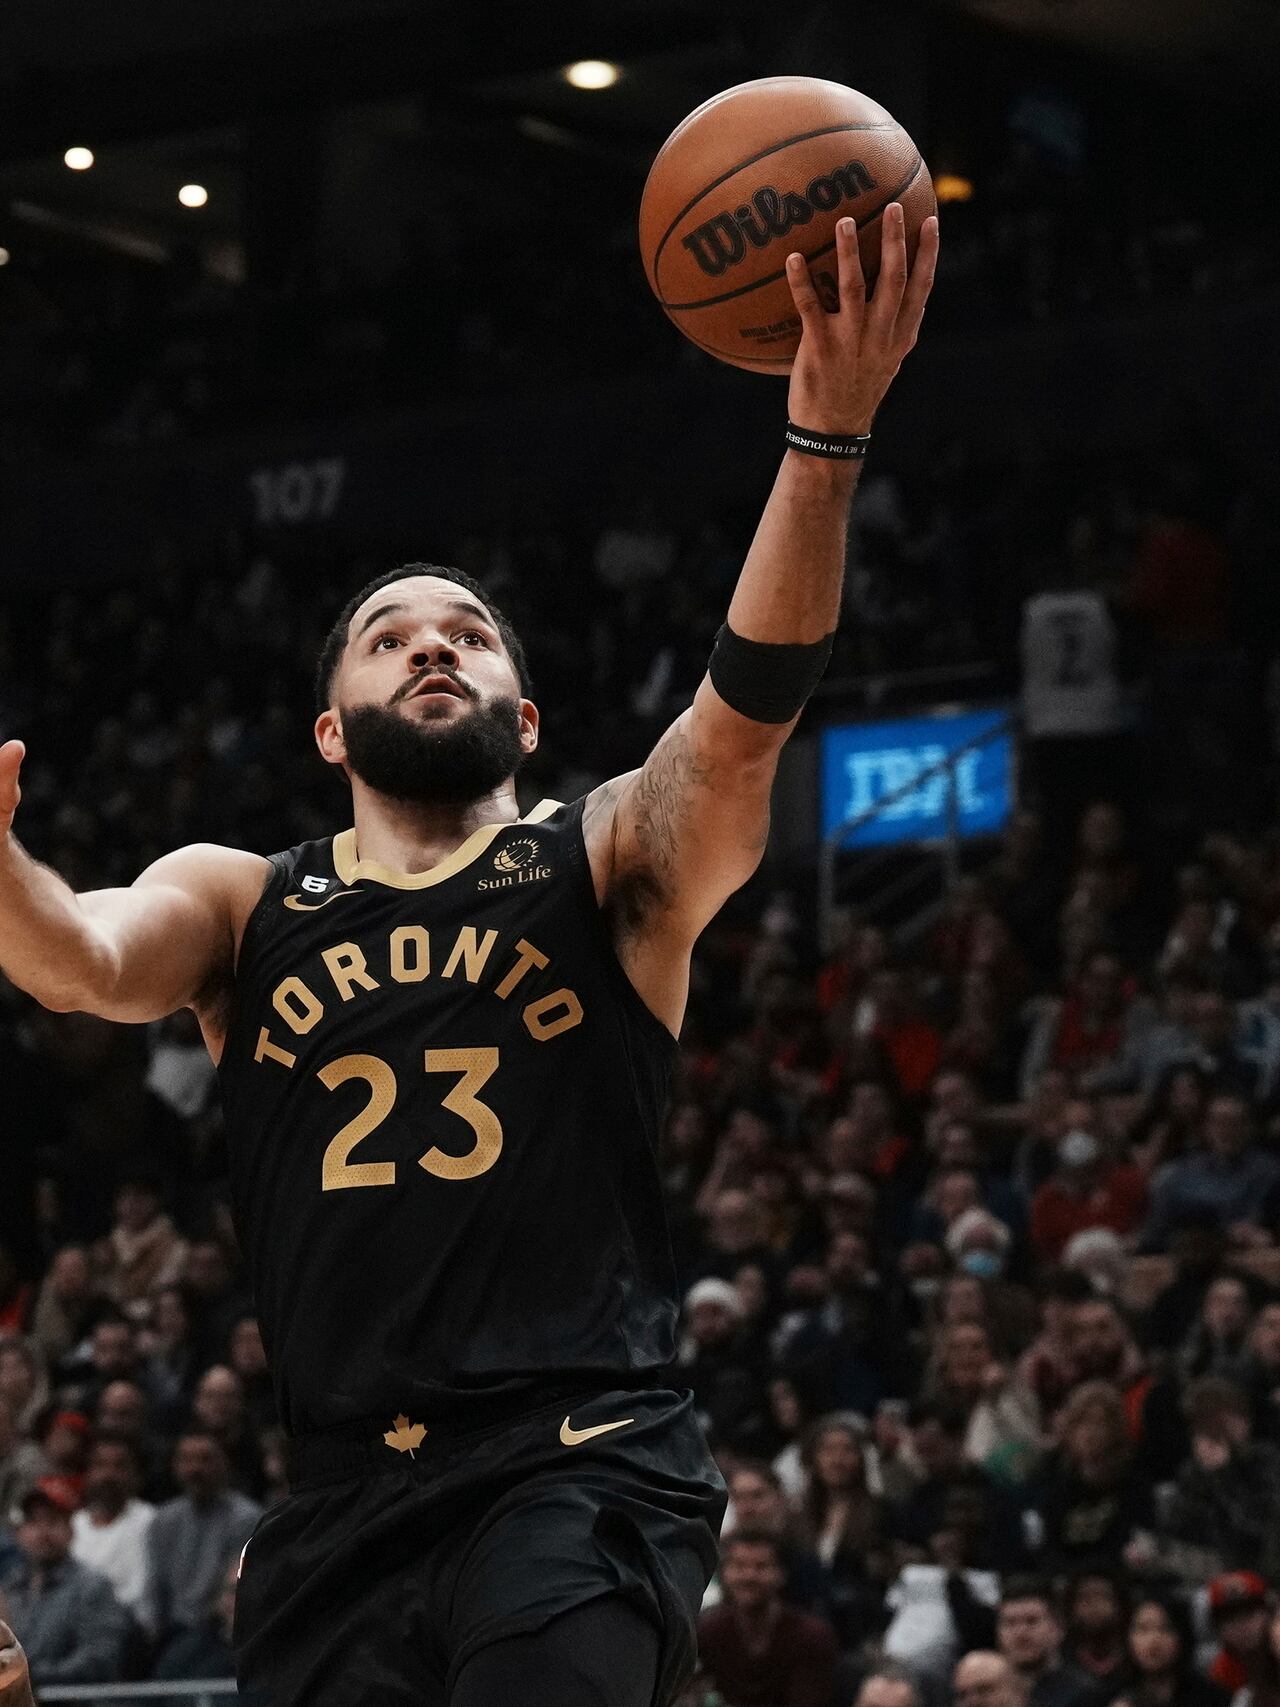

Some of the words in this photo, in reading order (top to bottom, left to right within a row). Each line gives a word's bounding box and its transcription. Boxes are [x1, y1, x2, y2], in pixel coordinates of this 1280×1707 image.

[682, 160, 879, 276] Wilson
[829, 445, 843, 454] ON
[250, 457, 346, 523] 107
[301, 874, 330, 893] 6
[477, 876, 513, 891] Sun
[517, 865, 552, 883] Life
[253, 924, 585, 1070] TORONTO
[316, 1046, 505, 1192] 23
